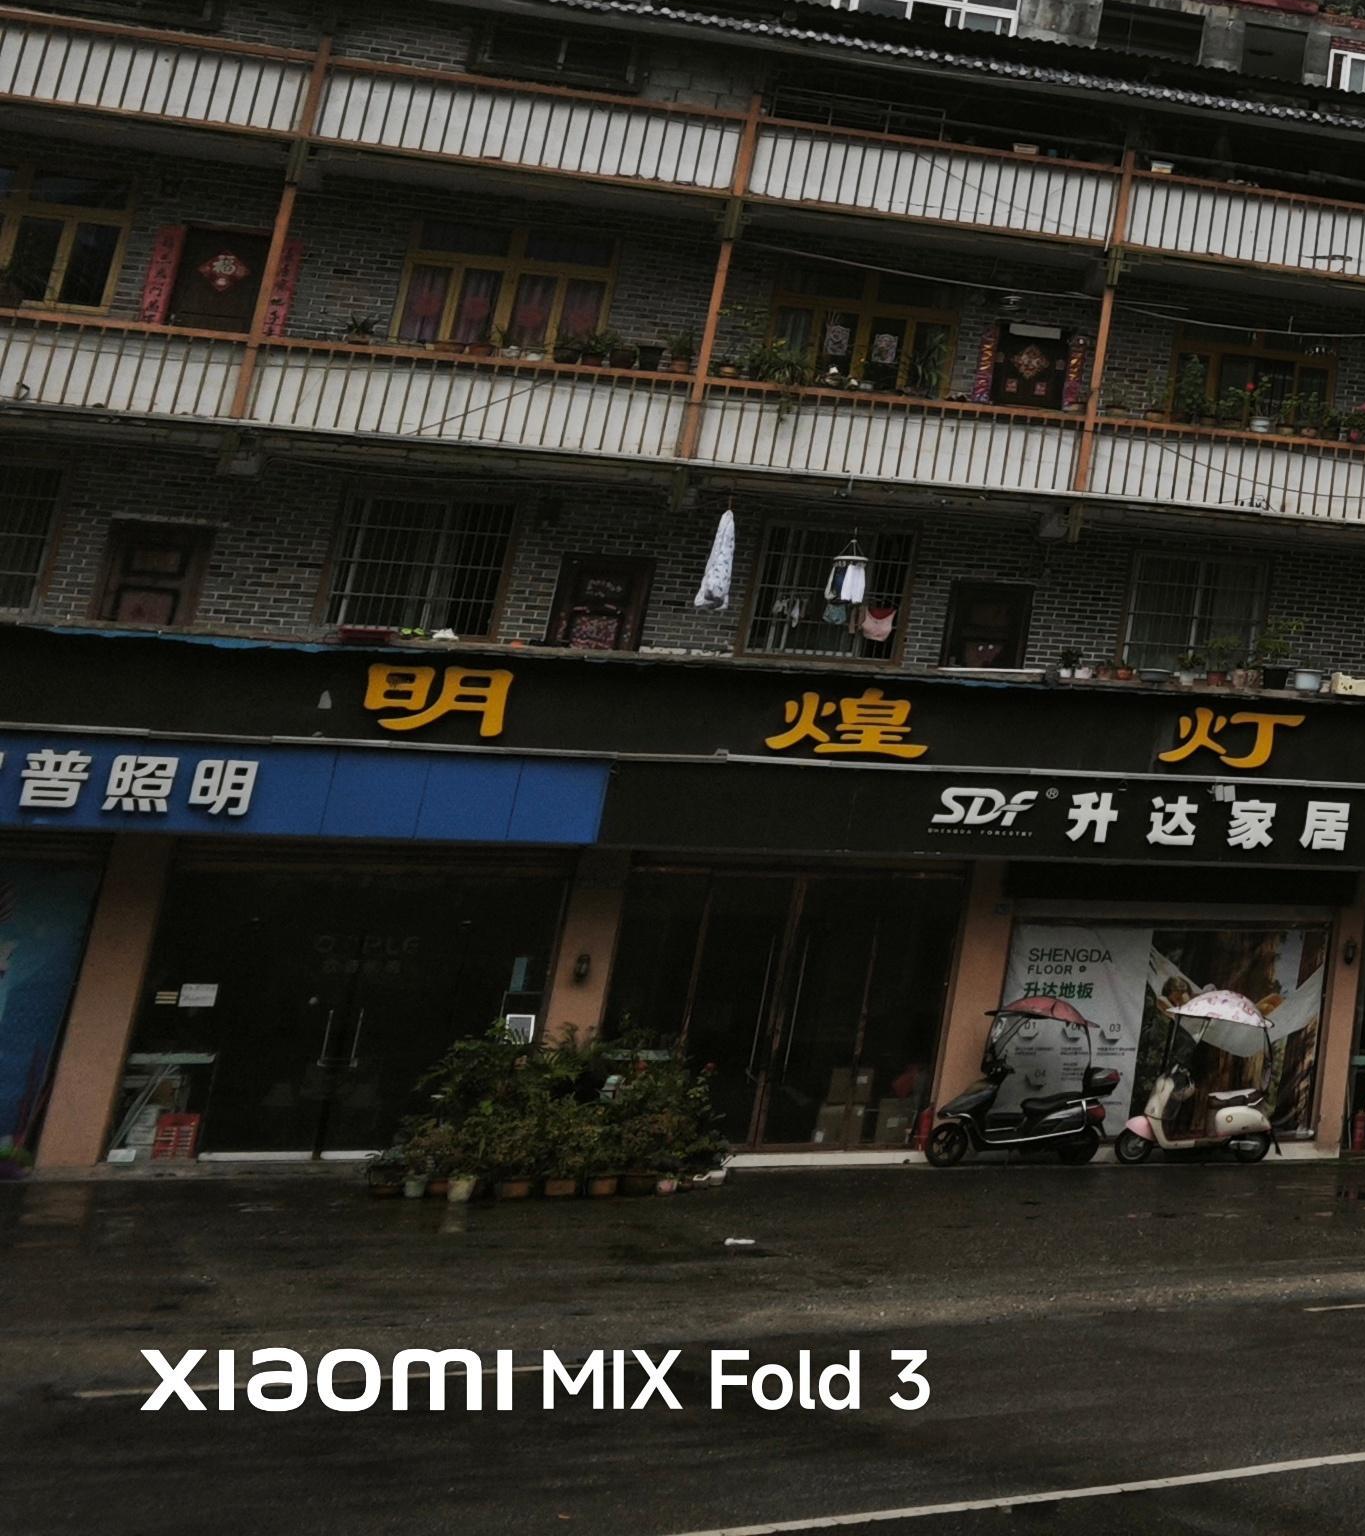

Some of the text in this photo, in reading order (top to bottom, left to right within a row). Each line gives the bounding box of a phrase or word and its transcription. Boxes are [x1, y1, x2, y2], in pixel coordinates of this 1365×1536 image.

[0, 749, 259, 816] 普照明
[1066, 790, 1351, 852] 升达家居
[1028, 948, 1113, 963] SHENGDA
[1027, 964, 1073, 975] FLOOR
[1023, 981, 1095, 1000] 升达地板
